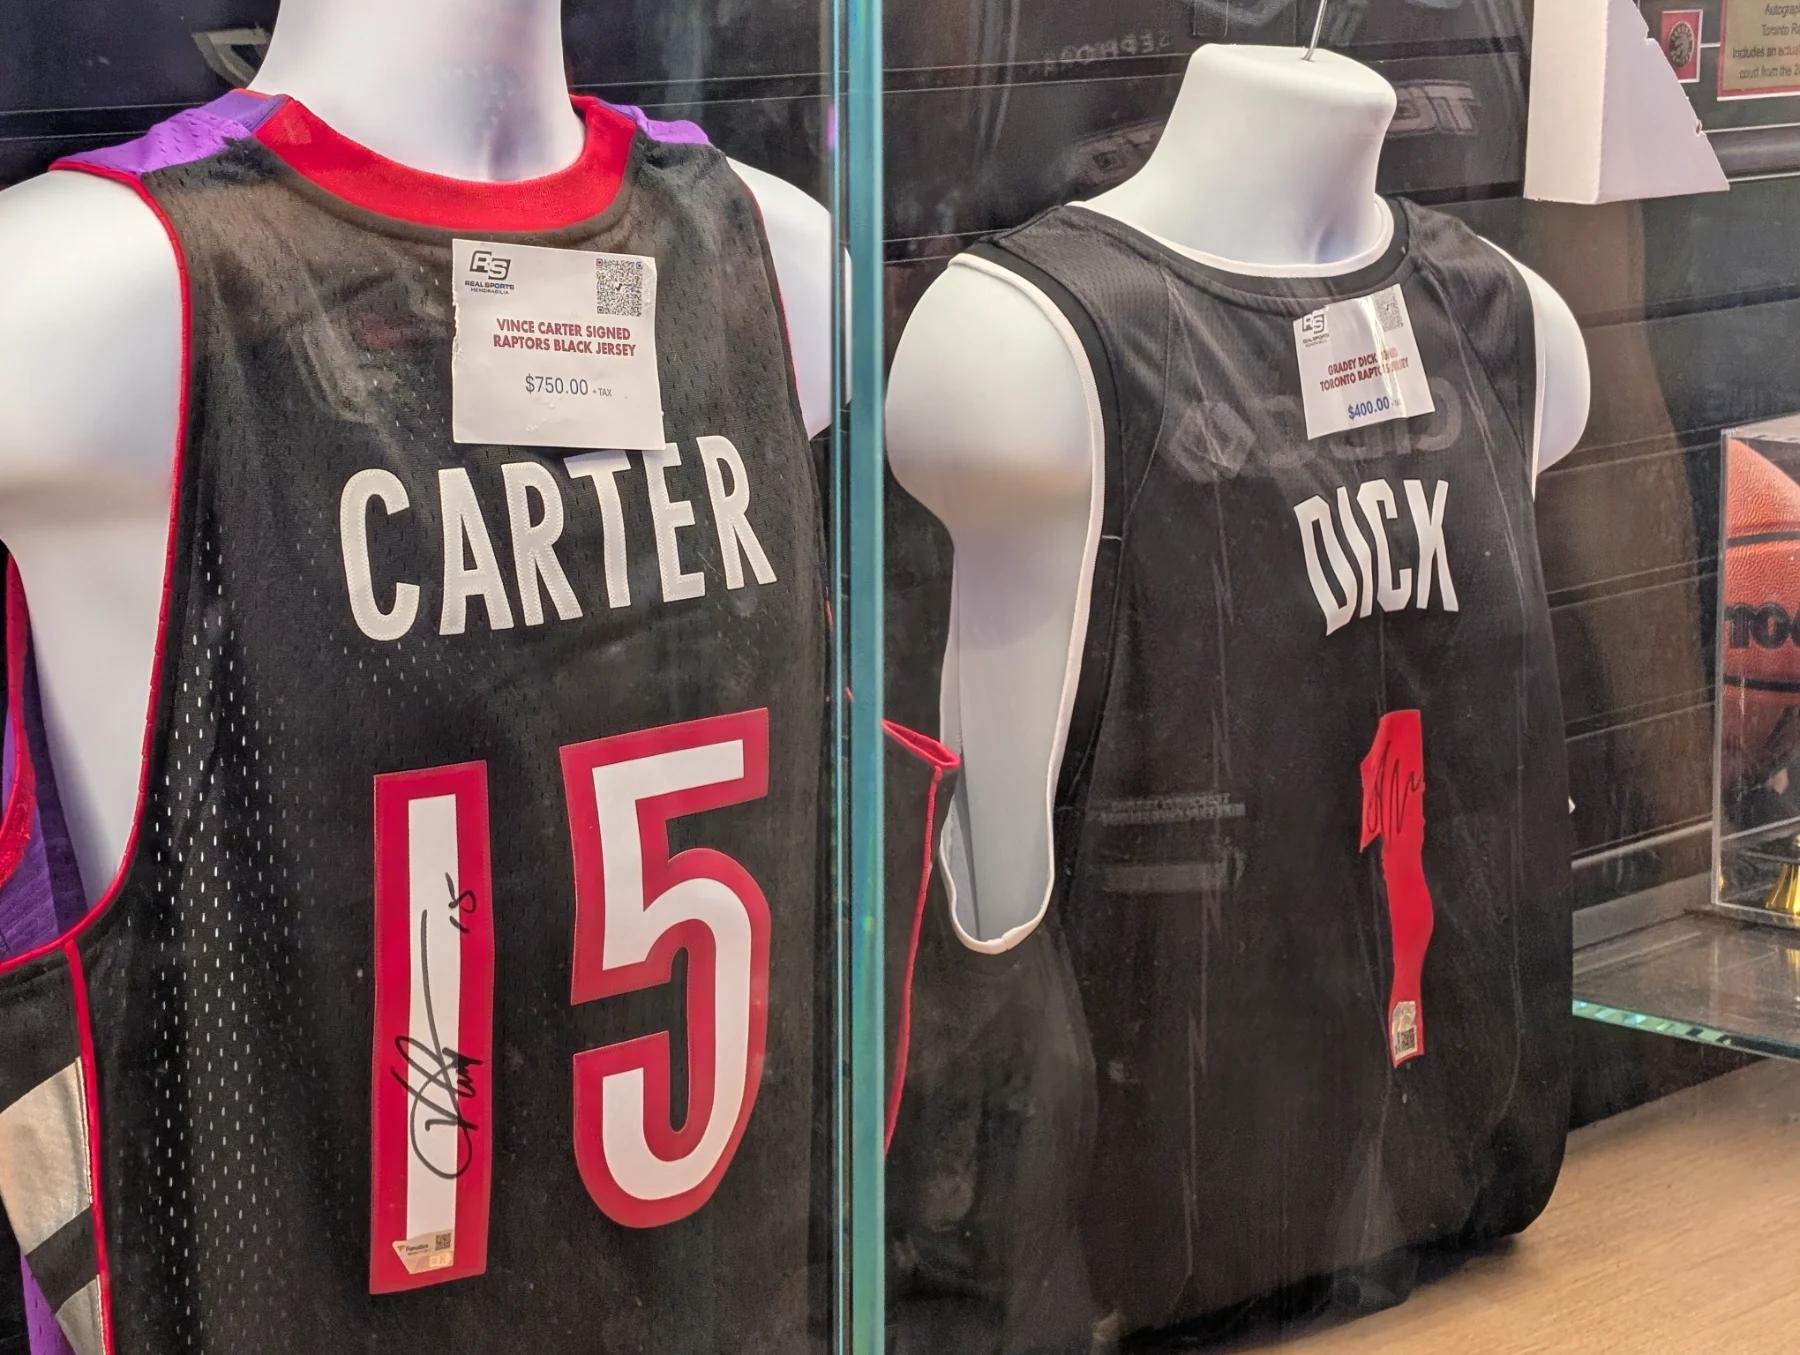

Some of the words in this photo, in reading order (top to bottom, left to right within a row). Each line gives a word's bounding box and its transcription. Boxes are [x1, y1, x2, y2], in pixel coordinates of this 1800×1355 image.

[496, 318, 535, 333] VINCE
[538, 321, 582, 337] CARTER
[586, 325, 631, 340] SIGNED
[493, 334, 550, 351] RAPTORS
[554, 339, 592, 354] BLACK
[595, 342, 636, 357] JERSEY
[1328, 358, 1357, 375] GRADEY
[1358, 352, 1378, 367] DICK
[525, 373, 588, 395] $750.00
[1320, 372, 1356, 391] TORONTO
[1348, 396, 1389, 420] $400.00
[340, 435, 777, 641] CARTER
[1294, 478, 1459, 636] DICK
[1359, 709, 1425, 1068] 1
[370, 707, 771, 1294] 15
